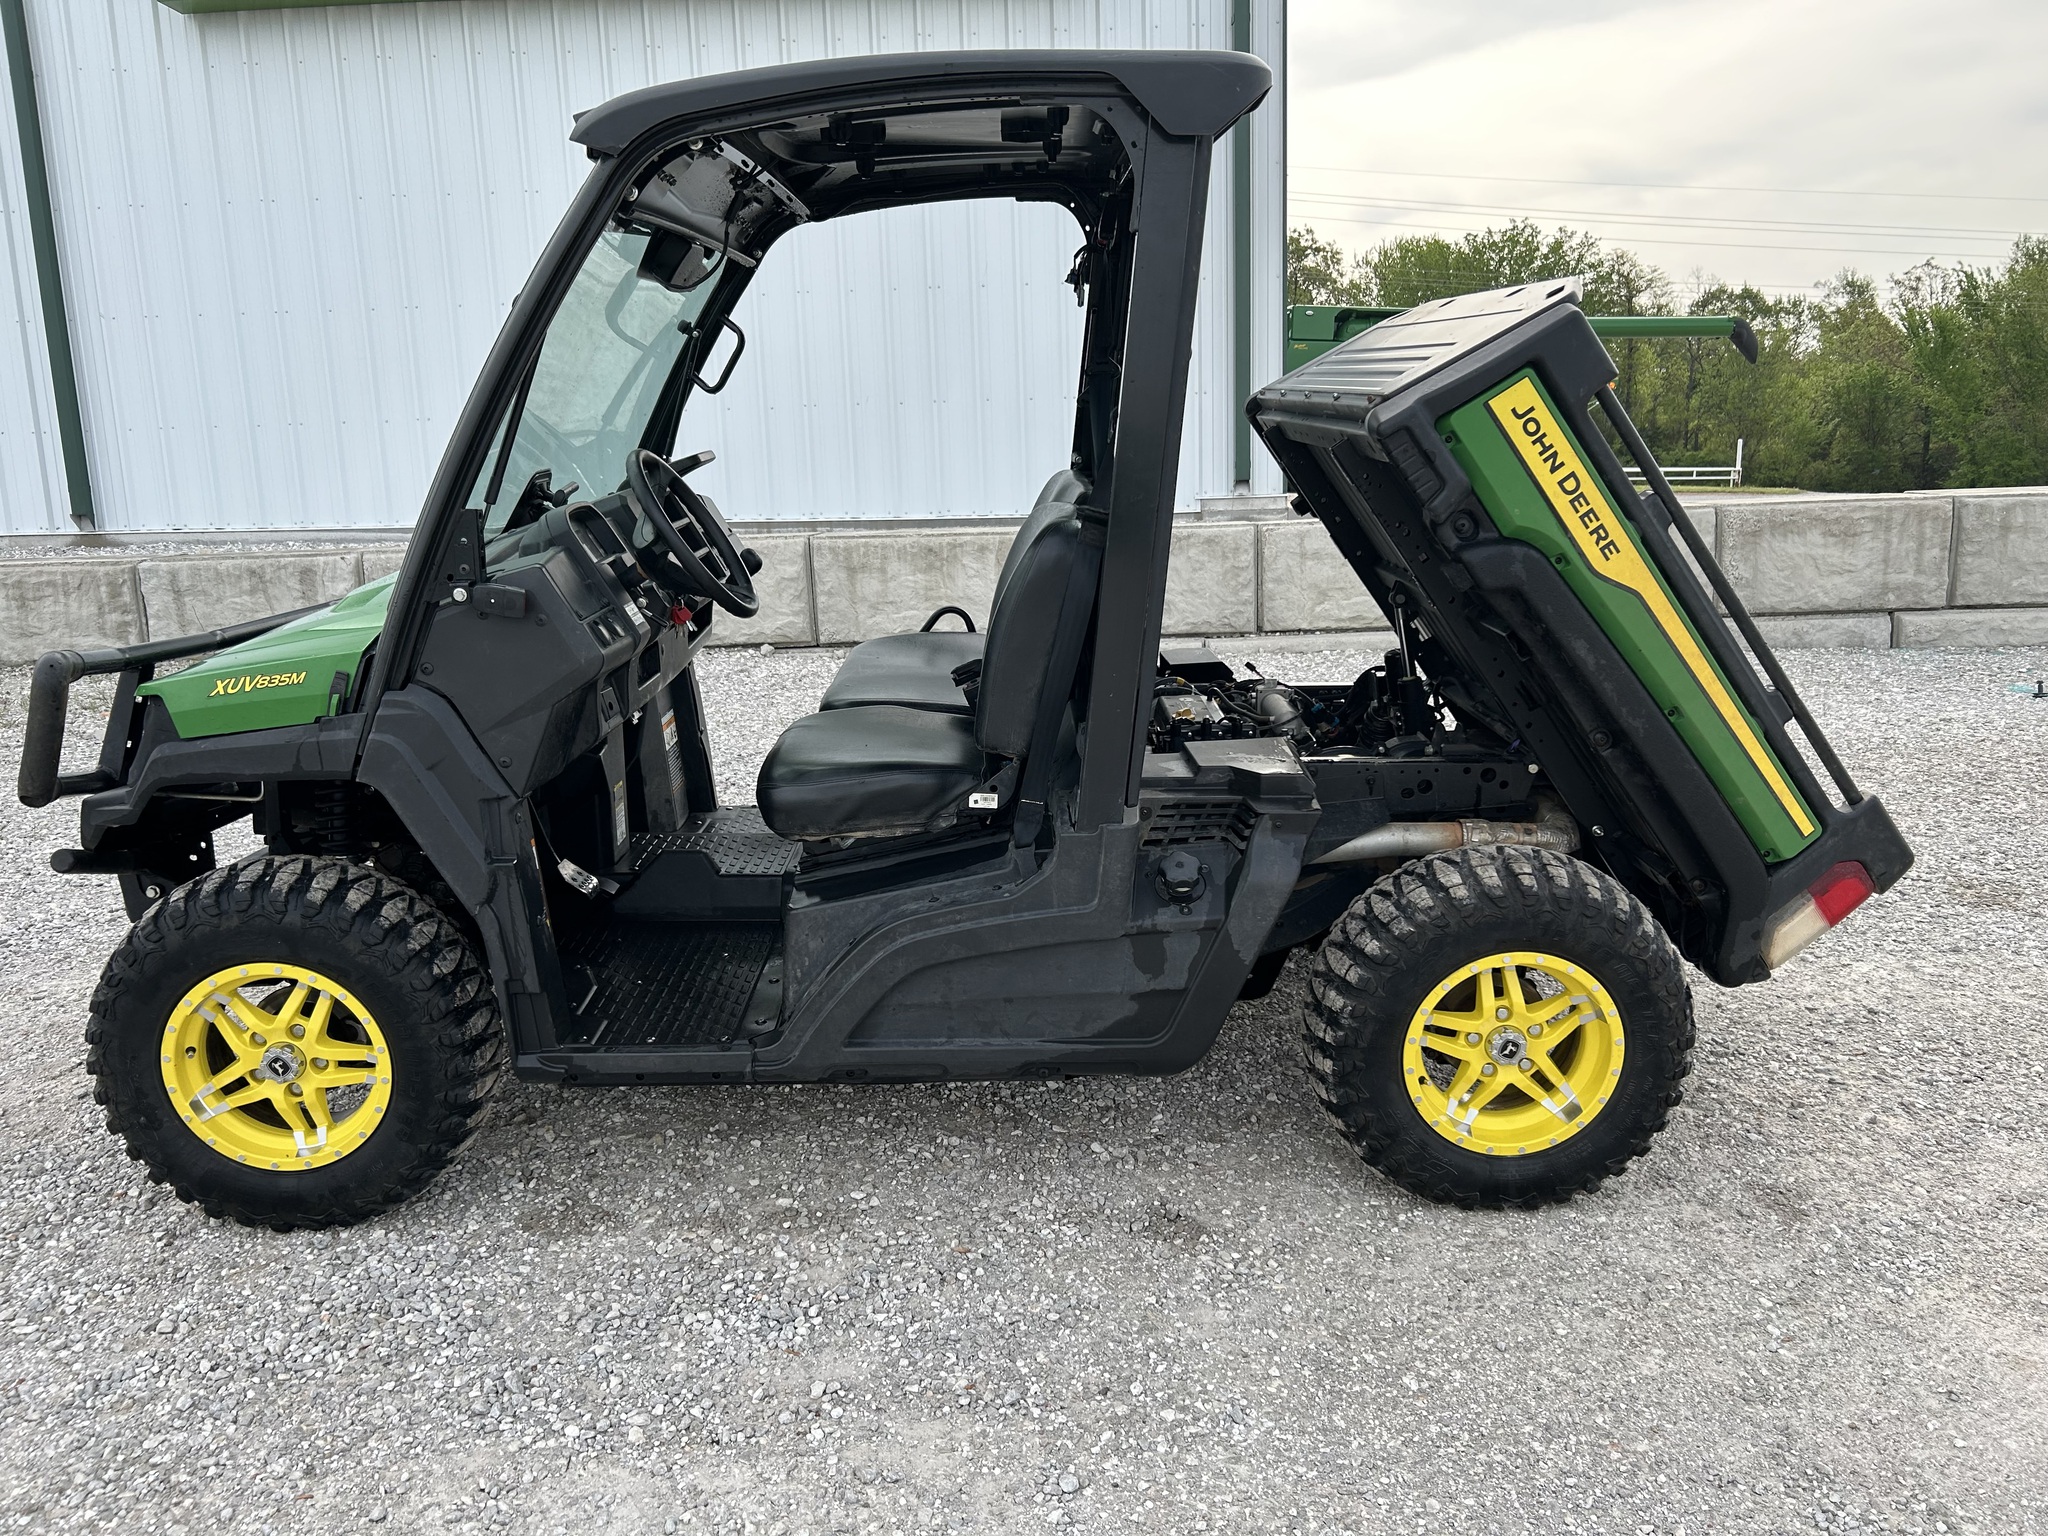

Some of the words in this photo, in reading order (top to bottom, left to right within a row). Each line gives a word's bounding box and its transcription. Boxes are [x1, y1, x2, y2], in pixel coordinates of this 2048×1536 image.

[1511, 406, 1565, 474] JOHN
[1557, 471, 1620, 561] DEERE
[208, 671, 307, 697] XUV835M
